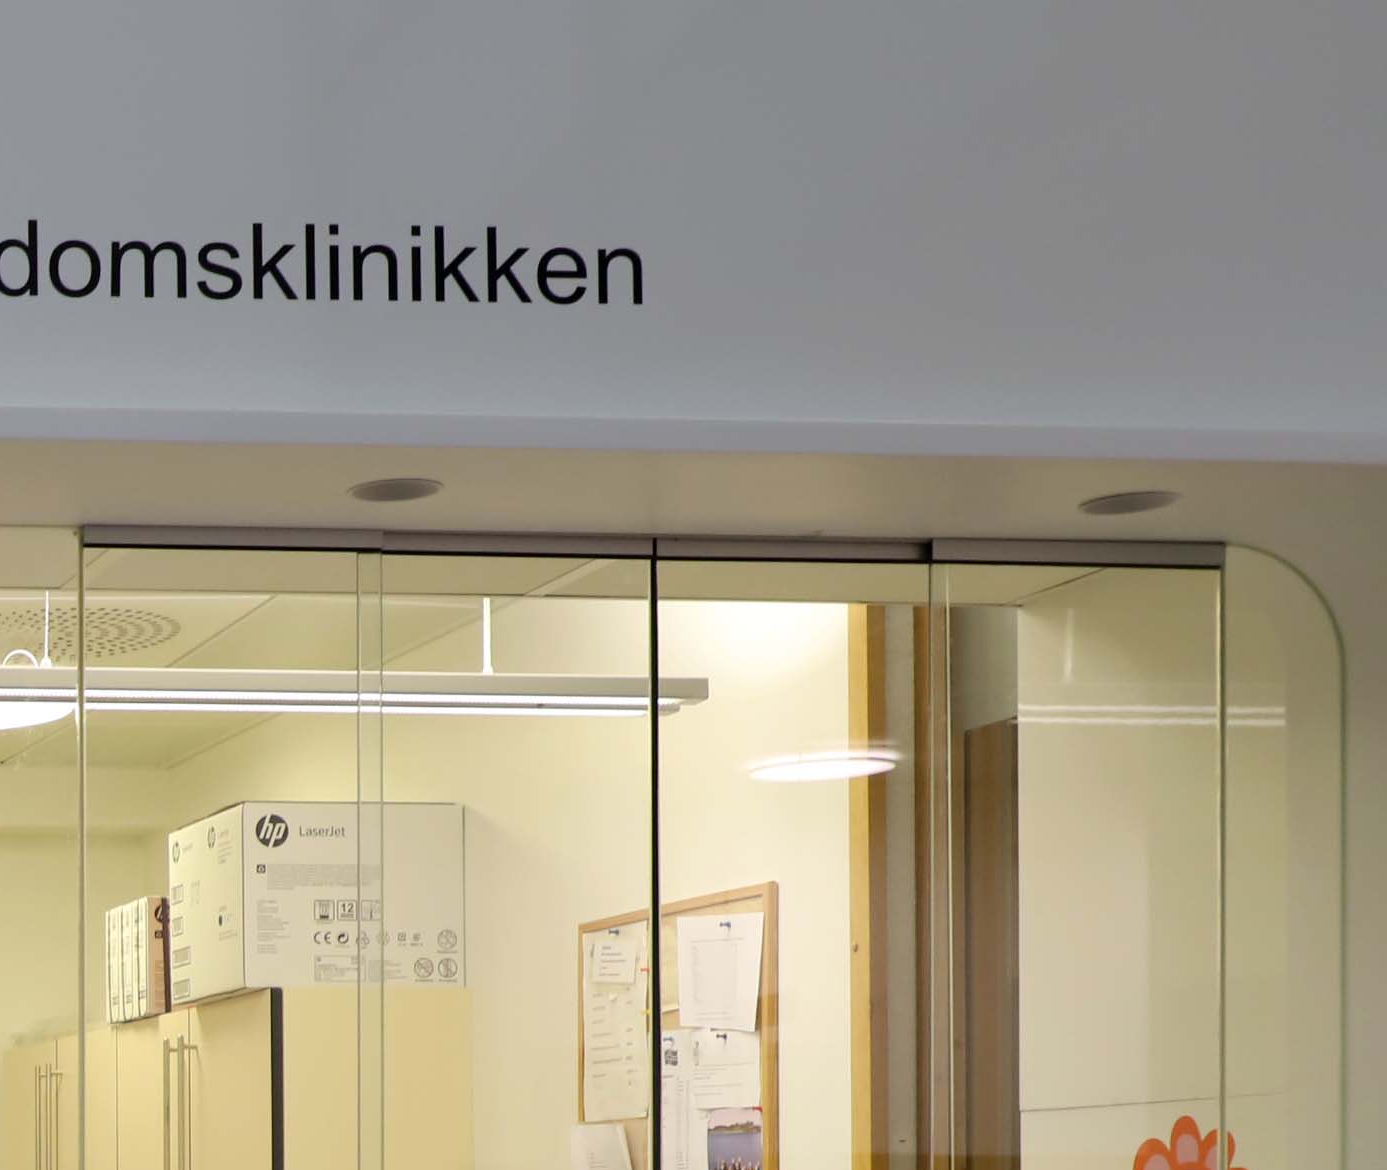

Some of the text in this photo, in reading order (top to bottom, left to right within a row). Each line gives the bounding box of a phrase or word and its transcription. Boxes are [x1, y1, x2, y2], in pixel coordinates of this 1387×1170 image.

[257, 814, 287, 848] hp
[299, 825, 346, 838] LaserJet
[341, 902, 355, 914] 12
